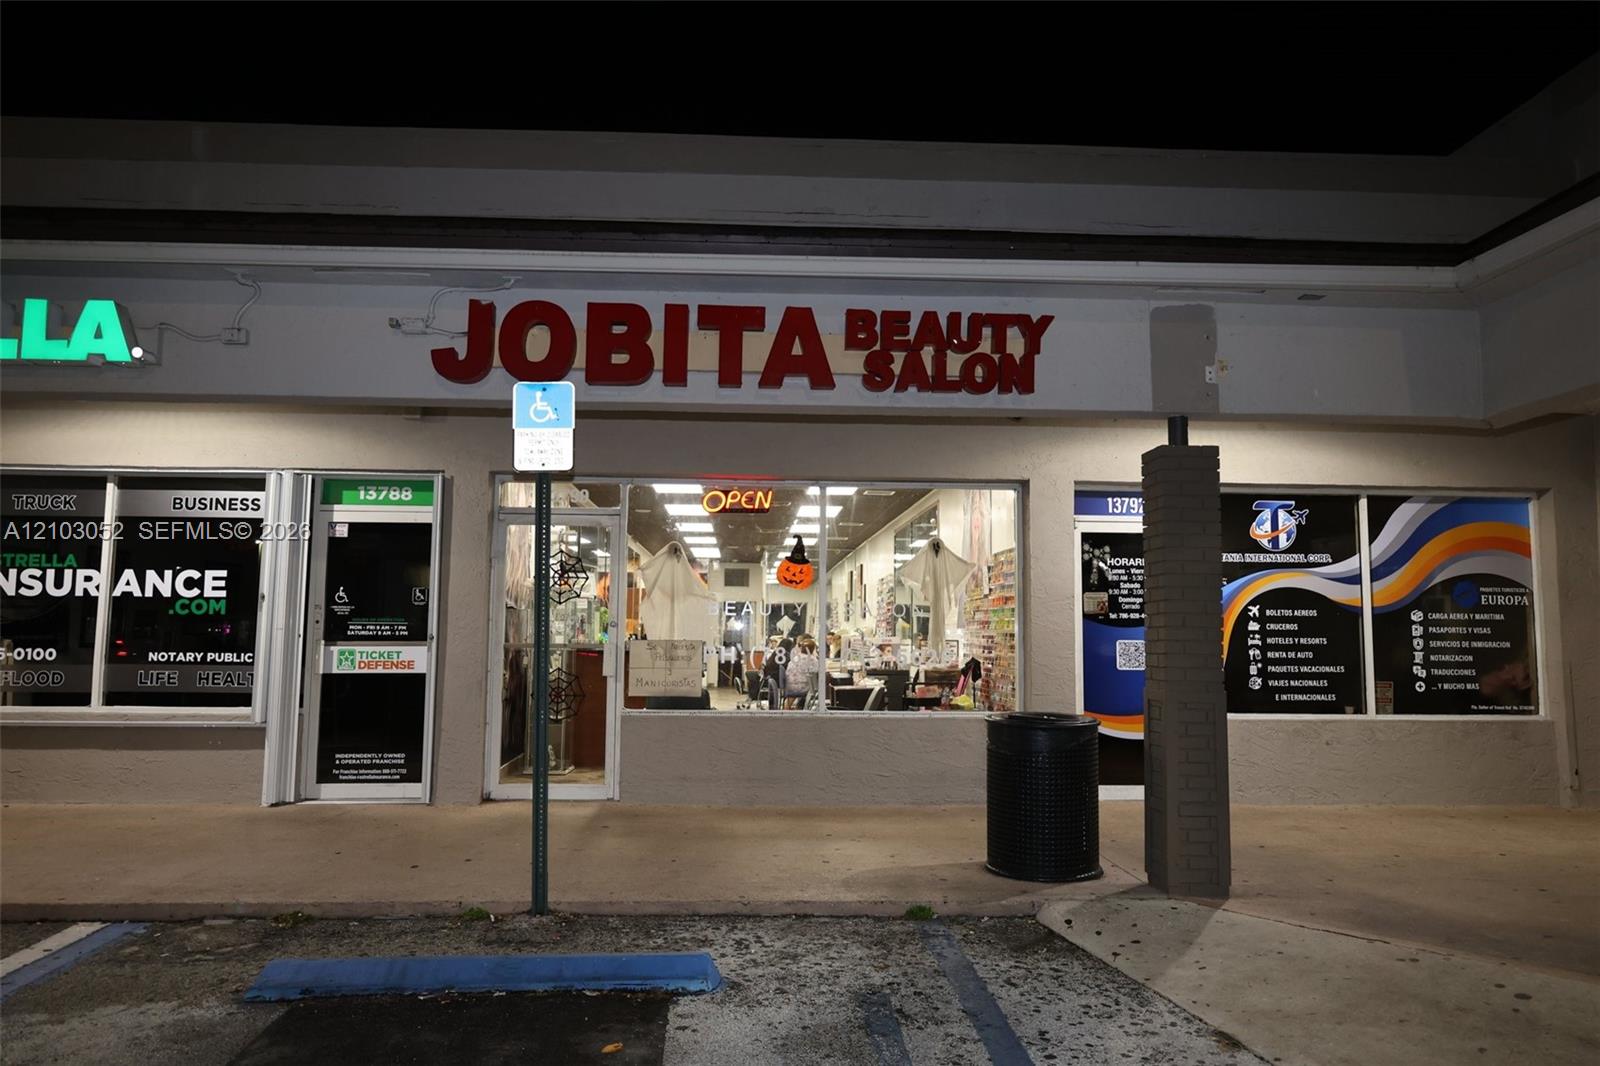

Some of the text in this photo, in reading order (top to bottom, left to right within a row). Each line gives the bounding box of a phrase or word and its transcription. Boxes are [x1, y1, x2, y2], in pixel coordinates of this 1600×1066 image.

[845, 309, 1055, 354] BEAUTY
[430, 299, 837, 390] JOBITA
[862, 350, 1035, 394] SALON
[358, 486, 413, 500] 13788
[12, 494, 76, 511] TRUCK
[171, 496, 261, 512] BUSINESS
[702, 489, 773, 513] OPEN
[0, 553, 78, 567] TRELLA
[1244, 553, 1307, 563] INTERNATIONAL
[1481, 595, 1530, 606] EUROPA
[168, 599, 226, 615] .COM
[1266, 609, 1318, 617] BOLETOS AEREOS
[1428, 612, 1449, 620] CARGA
[1266, 623, 1299, 631] CRUCEROS
[1429, 626, 1467, 634] PASAPORTES
[1267, 637, 1294, 645] HOTELES
[1300, 637, 1327, 645] RESORTS
[1429, 640, 1461, 648] SERVICIOS
[148, 652, 254, 662] NOTARY PUBLIC
[358, 650, 402, 660] TICKET
[1267, 651, 1313, 659] RENTA DE AUTO
[1430, 654, 1473, 662] NOTARIZACION
[358, 660, 415, 670] DEFENSE
[1267, 665, 1299, 673] PAQUETES
[1431, 668, 1476, 676] TRADUCCIONES
[137, 670, 179, 687] LIFE
